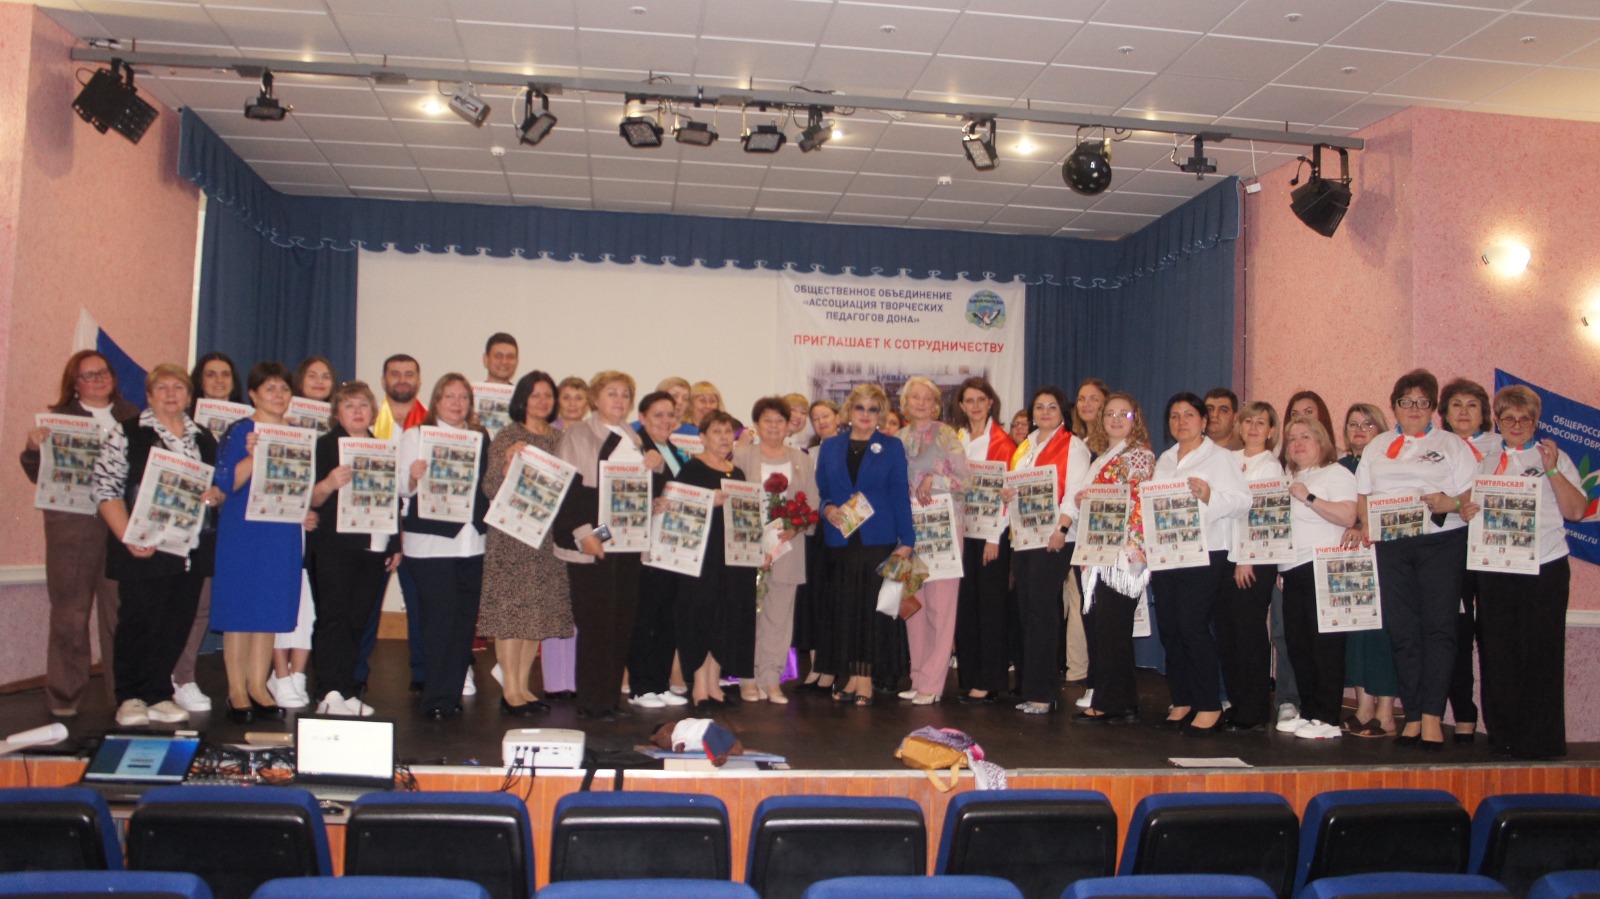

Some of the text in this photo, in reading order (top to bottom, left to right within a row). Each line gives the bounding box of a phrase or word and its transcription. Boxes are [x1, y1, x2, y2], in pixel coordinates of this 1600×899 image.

[794, 285, 952, 300] ОБЩЕСТВЕННОЕ ОБЪЕДИНЕНИЕ
[803, 298, 943, 312] «АССОЦИАЦИЯ ТВОРЧЕСКИХ
[826, 311, 920, 324] ПЕДАГОГОВ ДОНА»
[794, 335, 1005, 353] ПРИГЛАШАЕТ К СОТРУДНИЧЕСТВУ
[1584, 438, 1600, 450] ОБР
[1142, 480, 1185, 493] учительская
[1475, 479, 1525, 488] учительская
[1369, 495, 1414, 508] учительская
